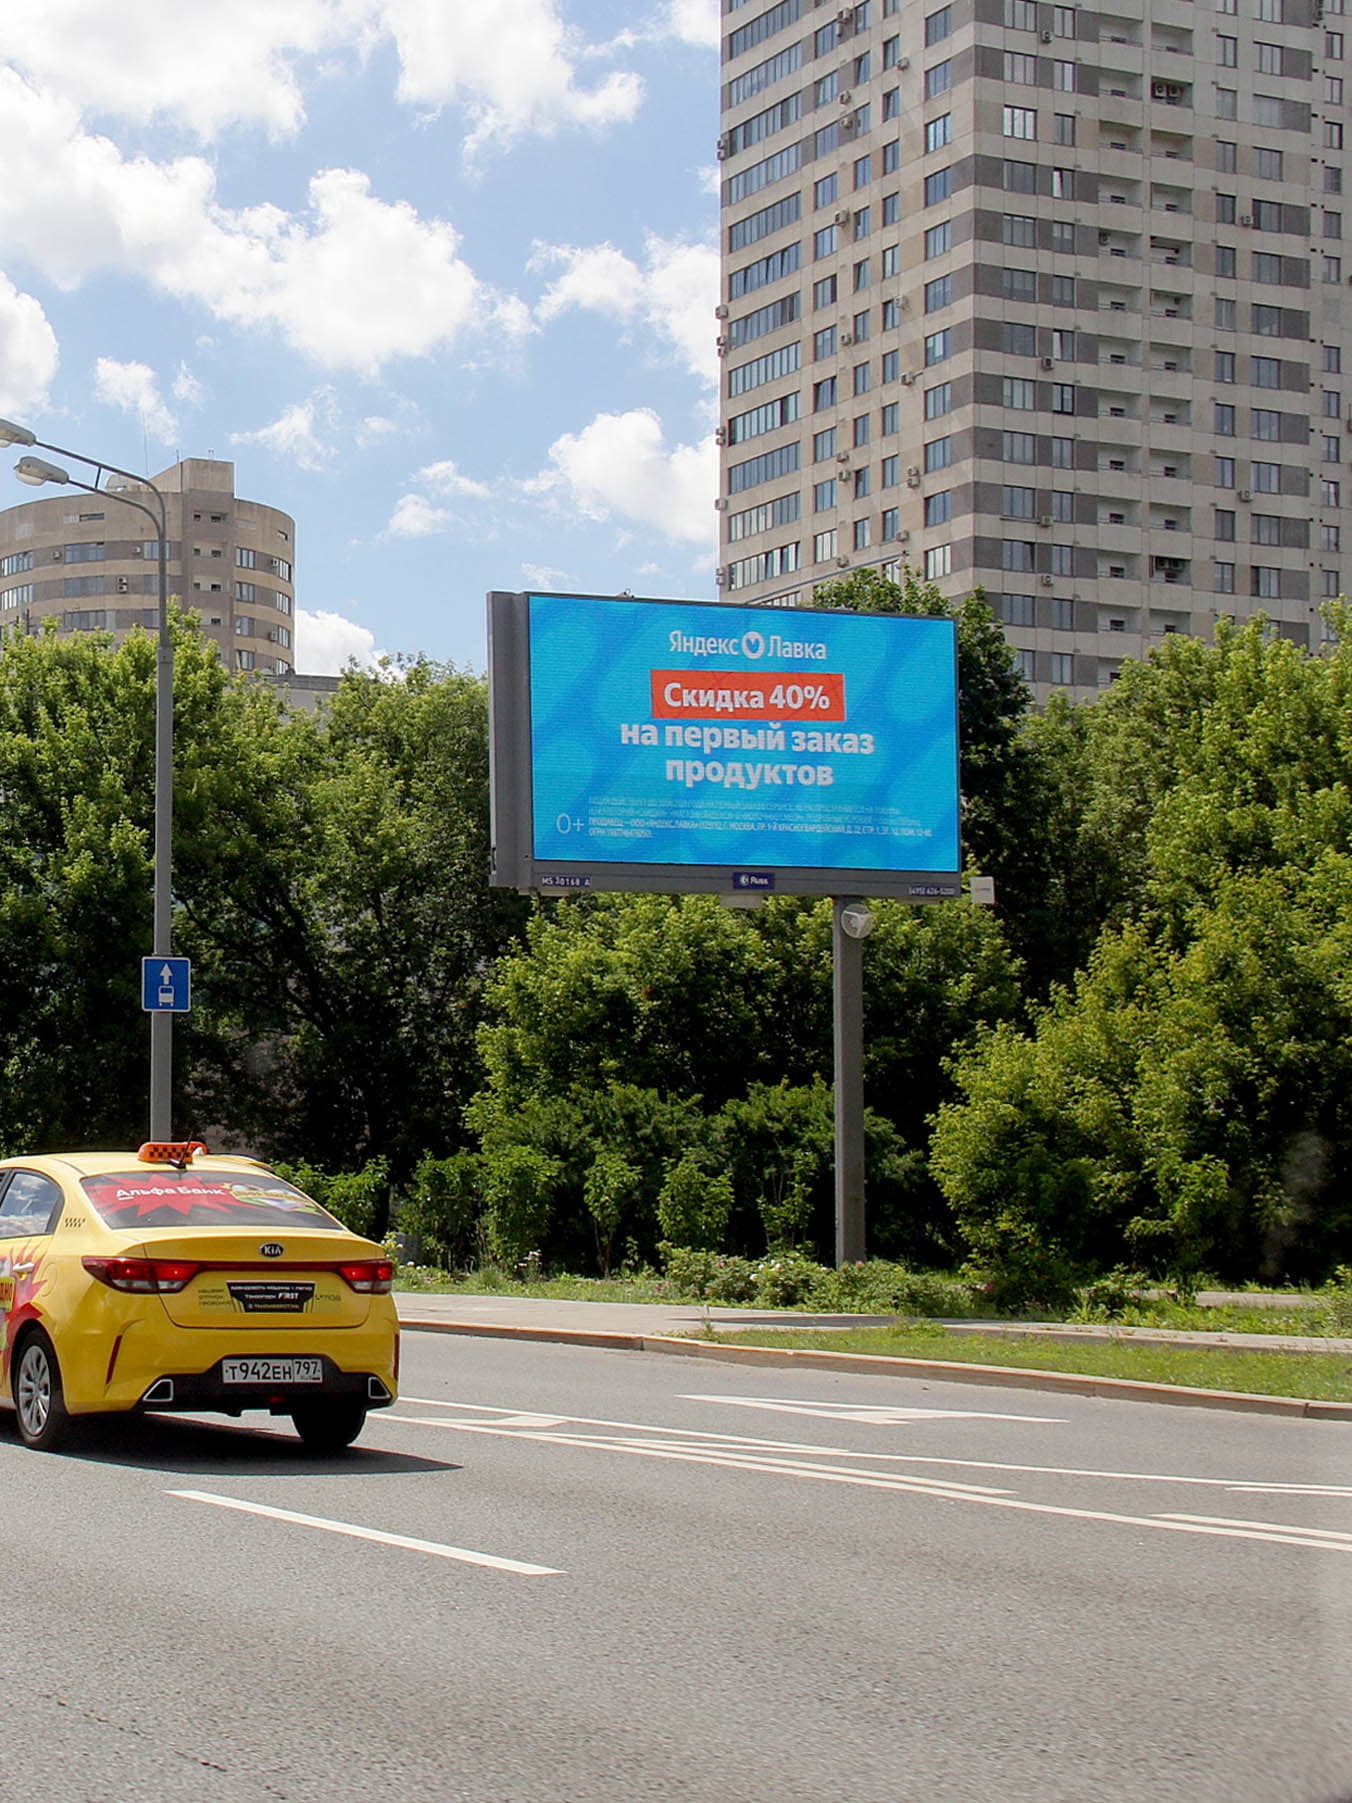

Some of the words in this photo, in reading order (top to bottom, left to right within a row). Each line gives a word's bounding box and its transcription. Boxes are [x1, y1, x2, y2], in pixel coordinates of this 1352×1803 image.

[669, 630, 740, 656] Яндекс
[768, 635, 827, 659] Лавка
[664, 682, 765, 712] Скидка
[769, 684, 831, 710] 40%
[620, 723, 659, 745] на
[665, 722, 785, 754] первый
[792, 732, 875, 754] заказ
[666, 759, 834, 790] продуктов
[556, 813, 585, 834] 0+
[116, 1187, 176, 1197] Альфа
[177, 1186, 225, 1196] Банк
[264, 1245, 282, 1255] KIA
[295, 1361, 318, 1374] 797
